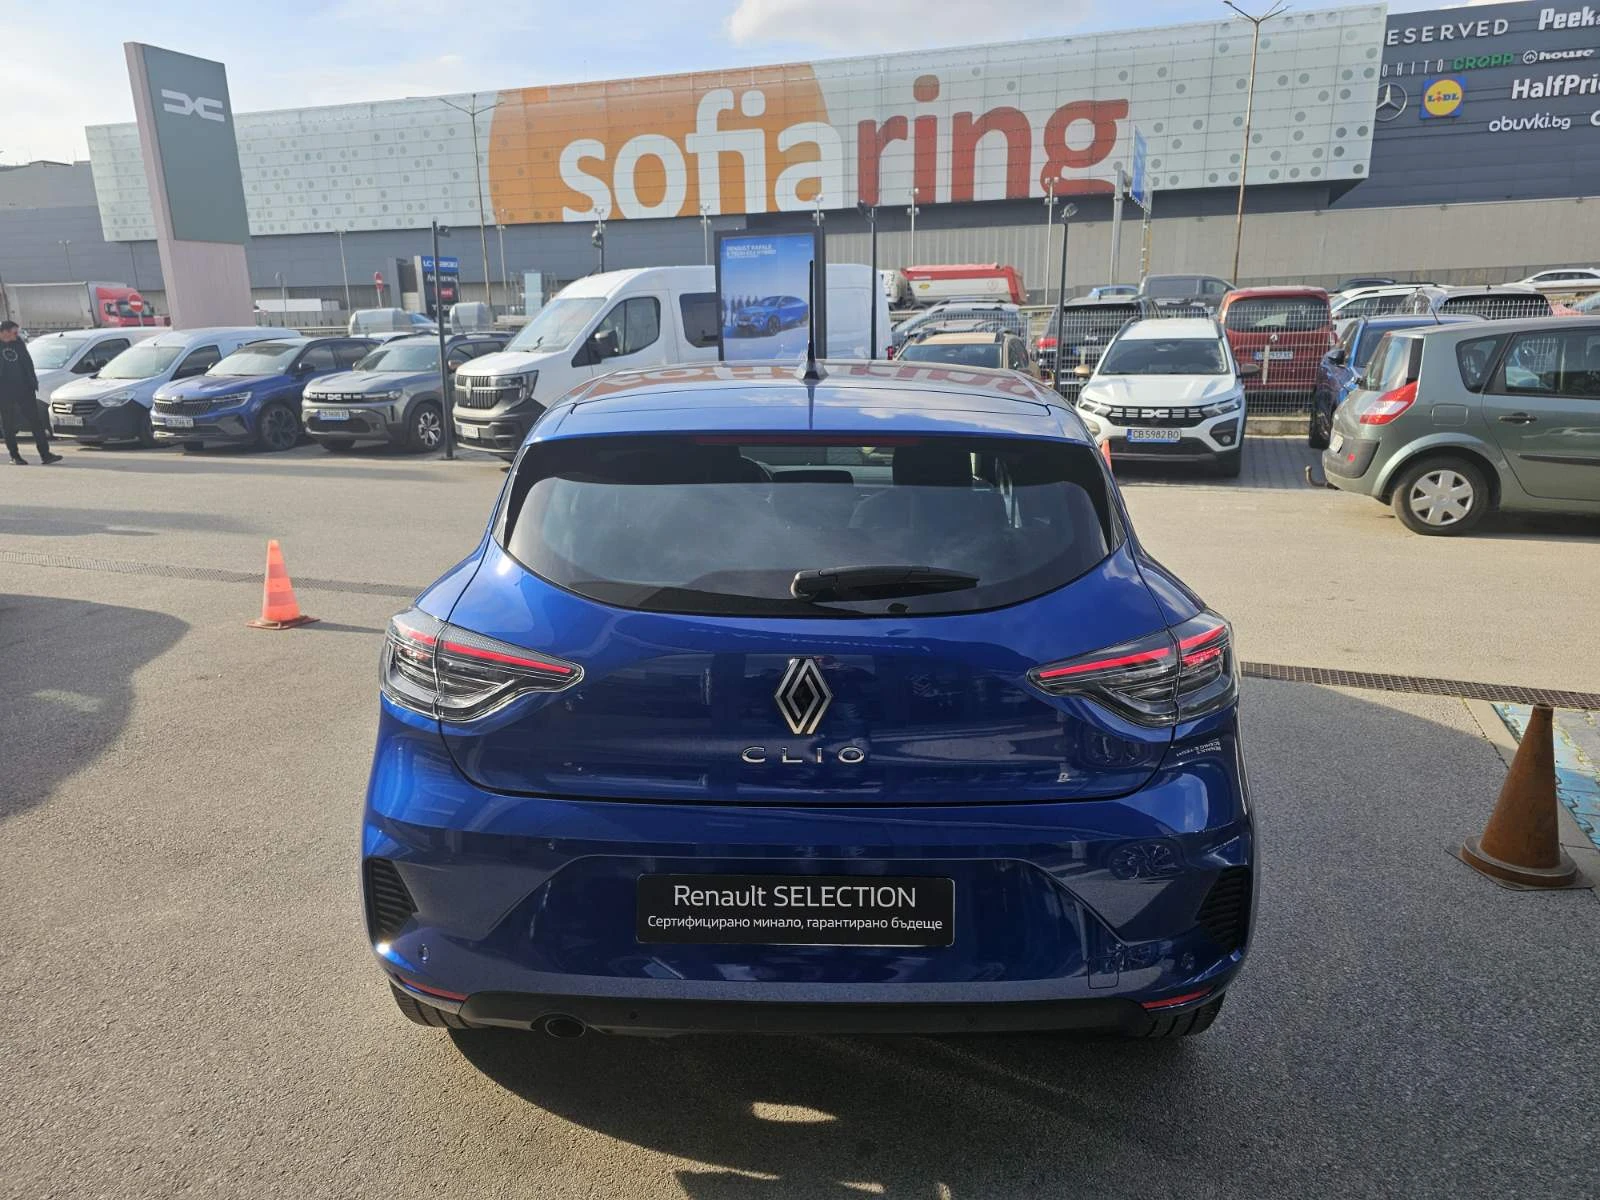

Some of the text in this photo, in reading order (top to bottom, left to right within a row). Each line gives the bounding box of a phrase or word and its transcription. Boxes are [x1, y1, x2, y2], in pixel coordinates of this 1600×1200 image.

[1538, 6, 1596, 31] Peek
[1511, 73, 1600, 100] HalfPri
[1488, 112, 1571, 132] obuvki.bg
[742, 747, 865, 763] CLIO
[673, 885, 916, 908] Renault SELECTION
[647, 915, 943, 931] Сертифицирано минало, гарантирано бъдеще
